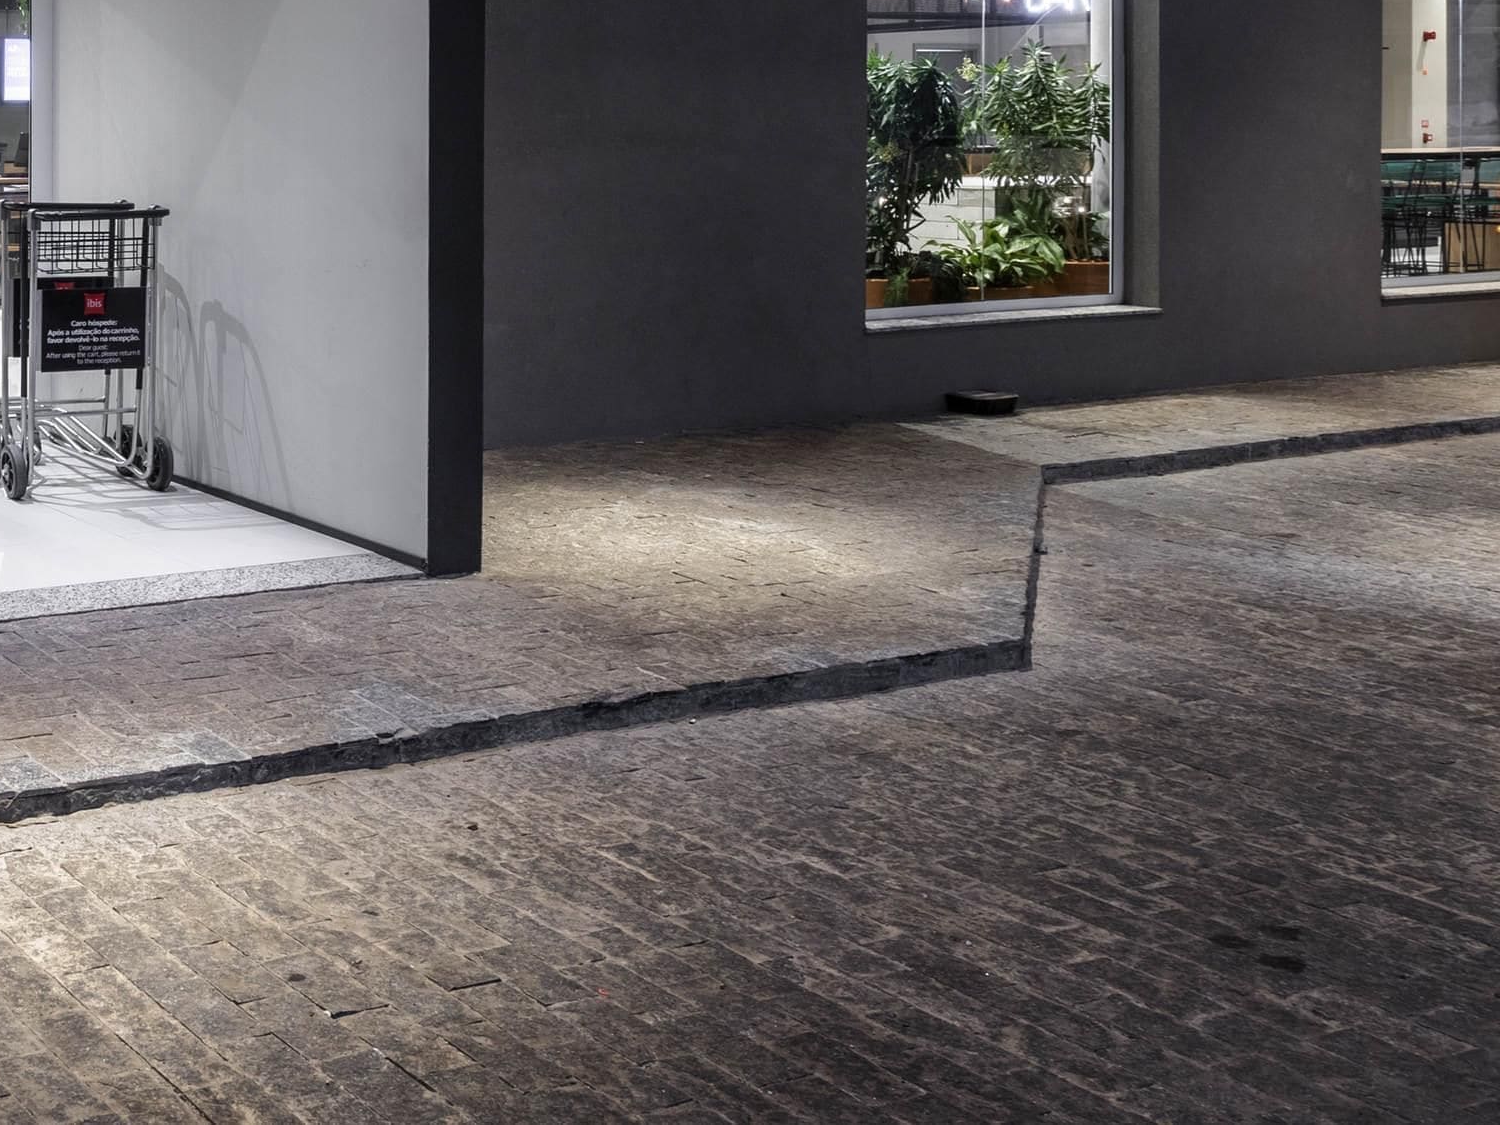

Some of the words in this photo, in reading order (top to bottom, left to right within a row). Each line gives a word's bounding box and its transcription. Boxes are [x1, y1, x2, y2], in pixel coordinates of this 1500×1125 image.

[87, 298, 102, 308] ibis
[47, 329, 64, 337] Após
[71, 328, 101, 336] utilização
[47, 336, 64, 344] favor
